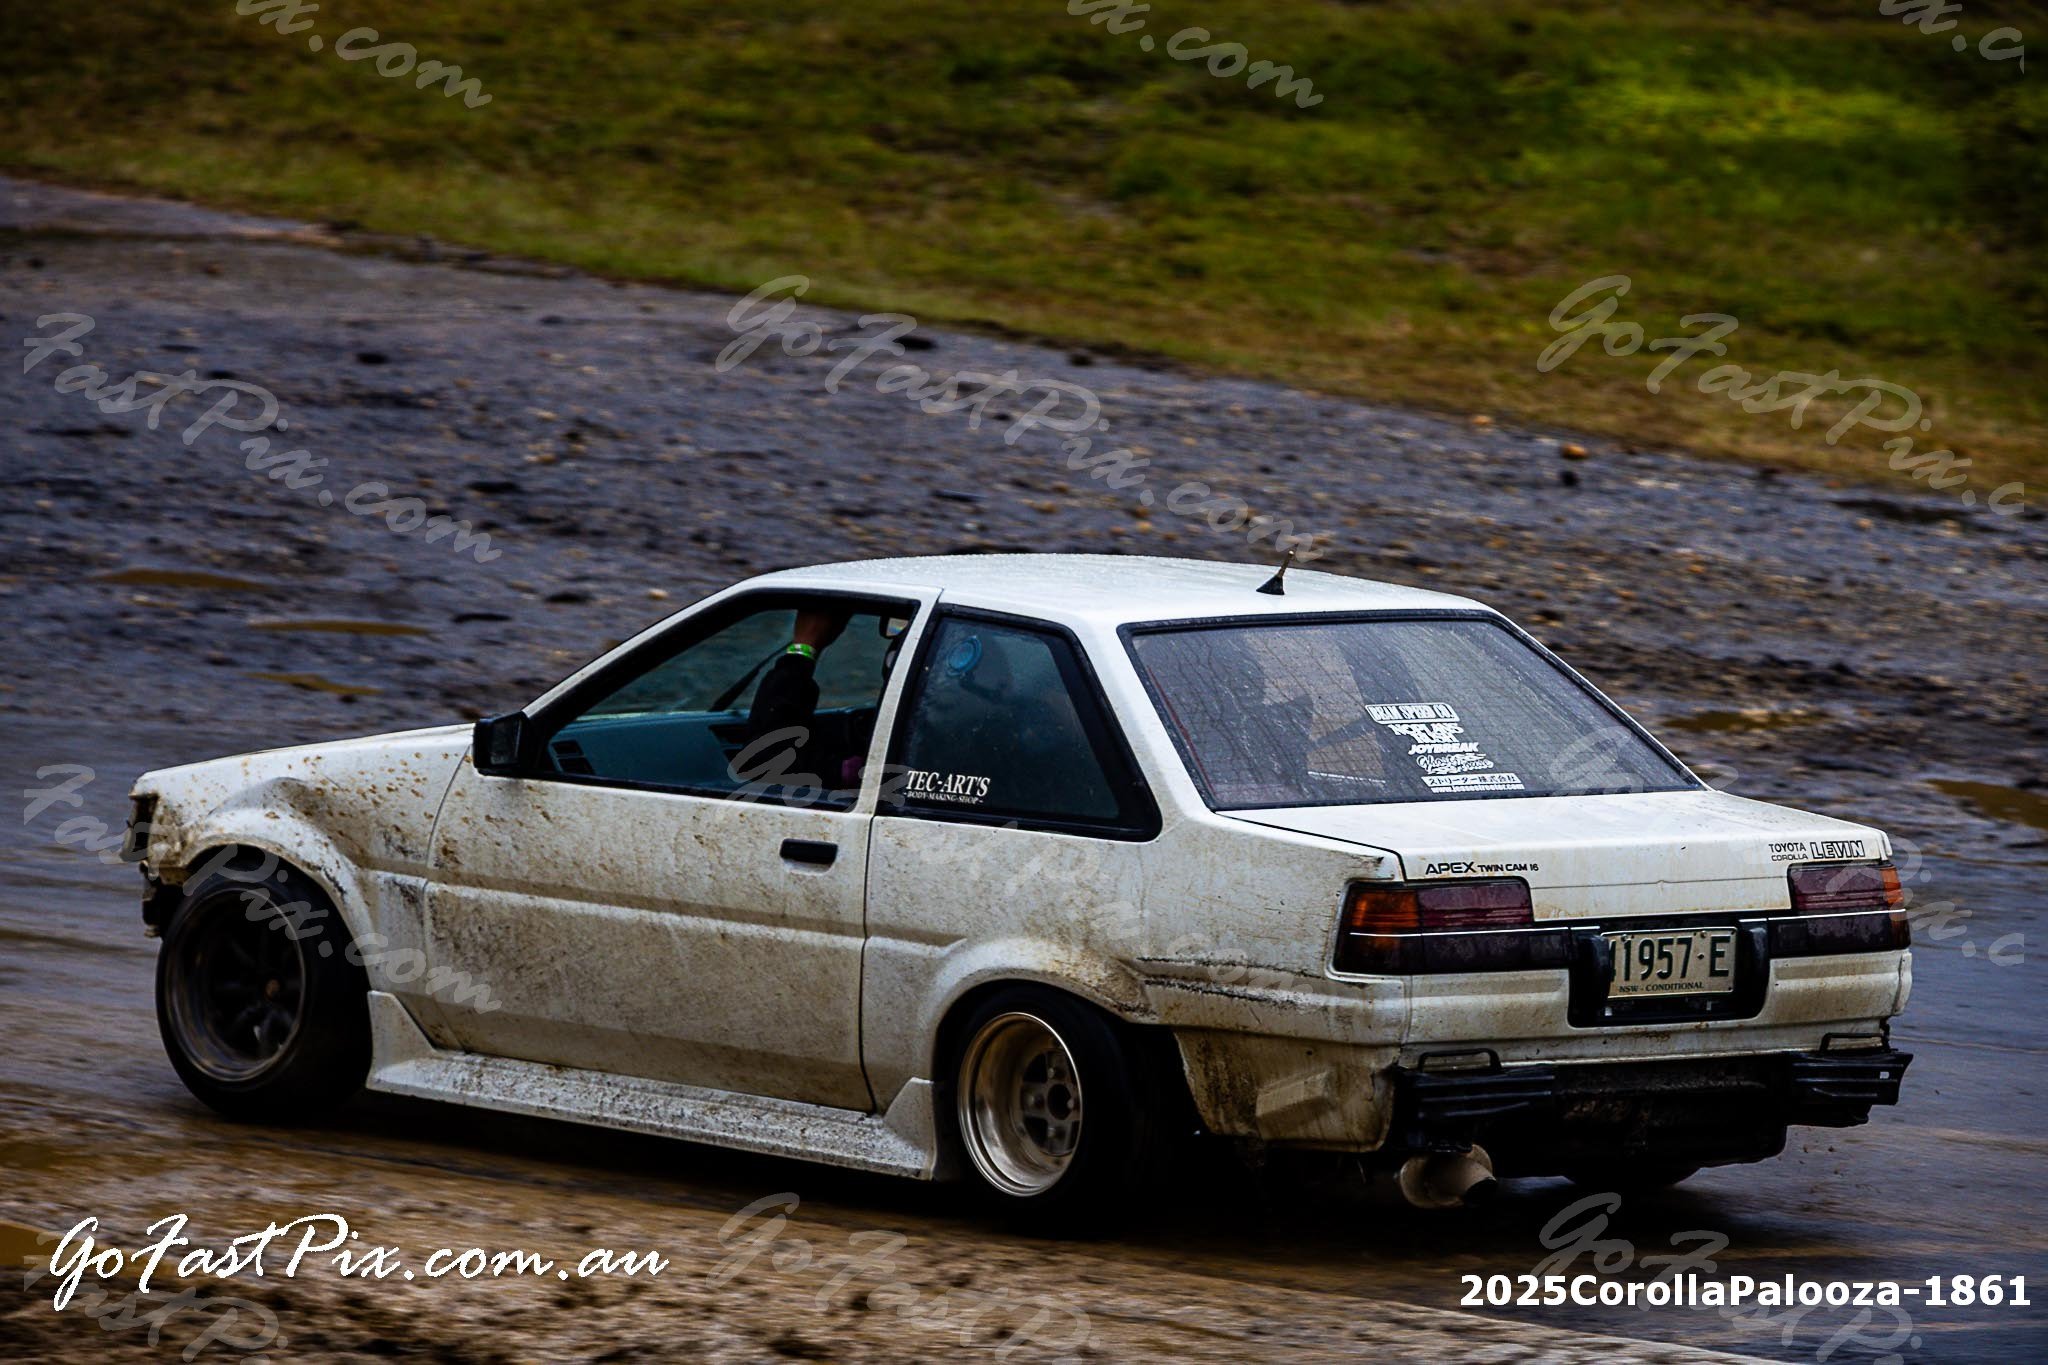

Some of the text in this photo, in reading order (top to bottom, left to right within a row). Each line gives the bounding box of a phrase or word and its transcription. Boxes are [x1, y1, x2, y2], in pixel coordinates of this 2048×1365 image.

[1768, 842, 1807, 853] TOYOTA
[1809, 840, 1866, 860] LEVIN
[1771, 853, 1809, 862] COROLLA
[1425, 861, 1539, 875] APEX TWIN CAM 16
[1619, 985, 1639, 993] NSW
[1645, 981, 1705, 992] CONDITIONAL
